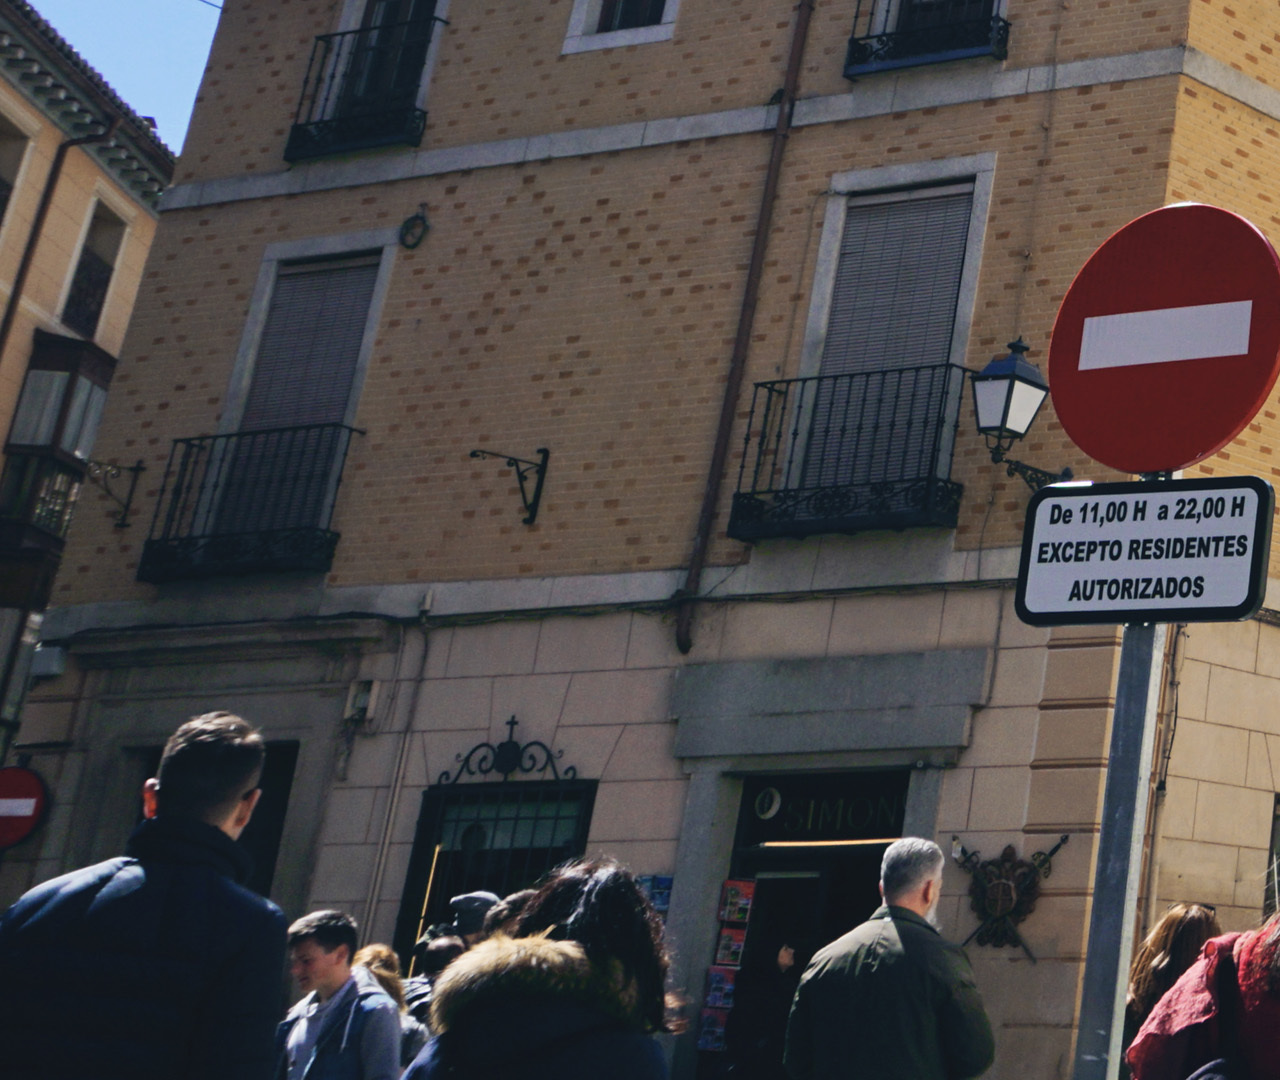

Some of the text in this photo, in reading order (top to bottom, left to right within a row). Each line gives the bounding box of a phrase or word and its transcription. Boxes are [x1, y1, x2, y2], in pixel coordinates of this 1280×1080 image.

[1049, 496, 1245, 528] De 11,00 H a 22,00 H
[1037, 535, 1248, 564] EXCEPTO RESIDENTES
[1068, 576, 1205, 602] AUTORIZADOS
